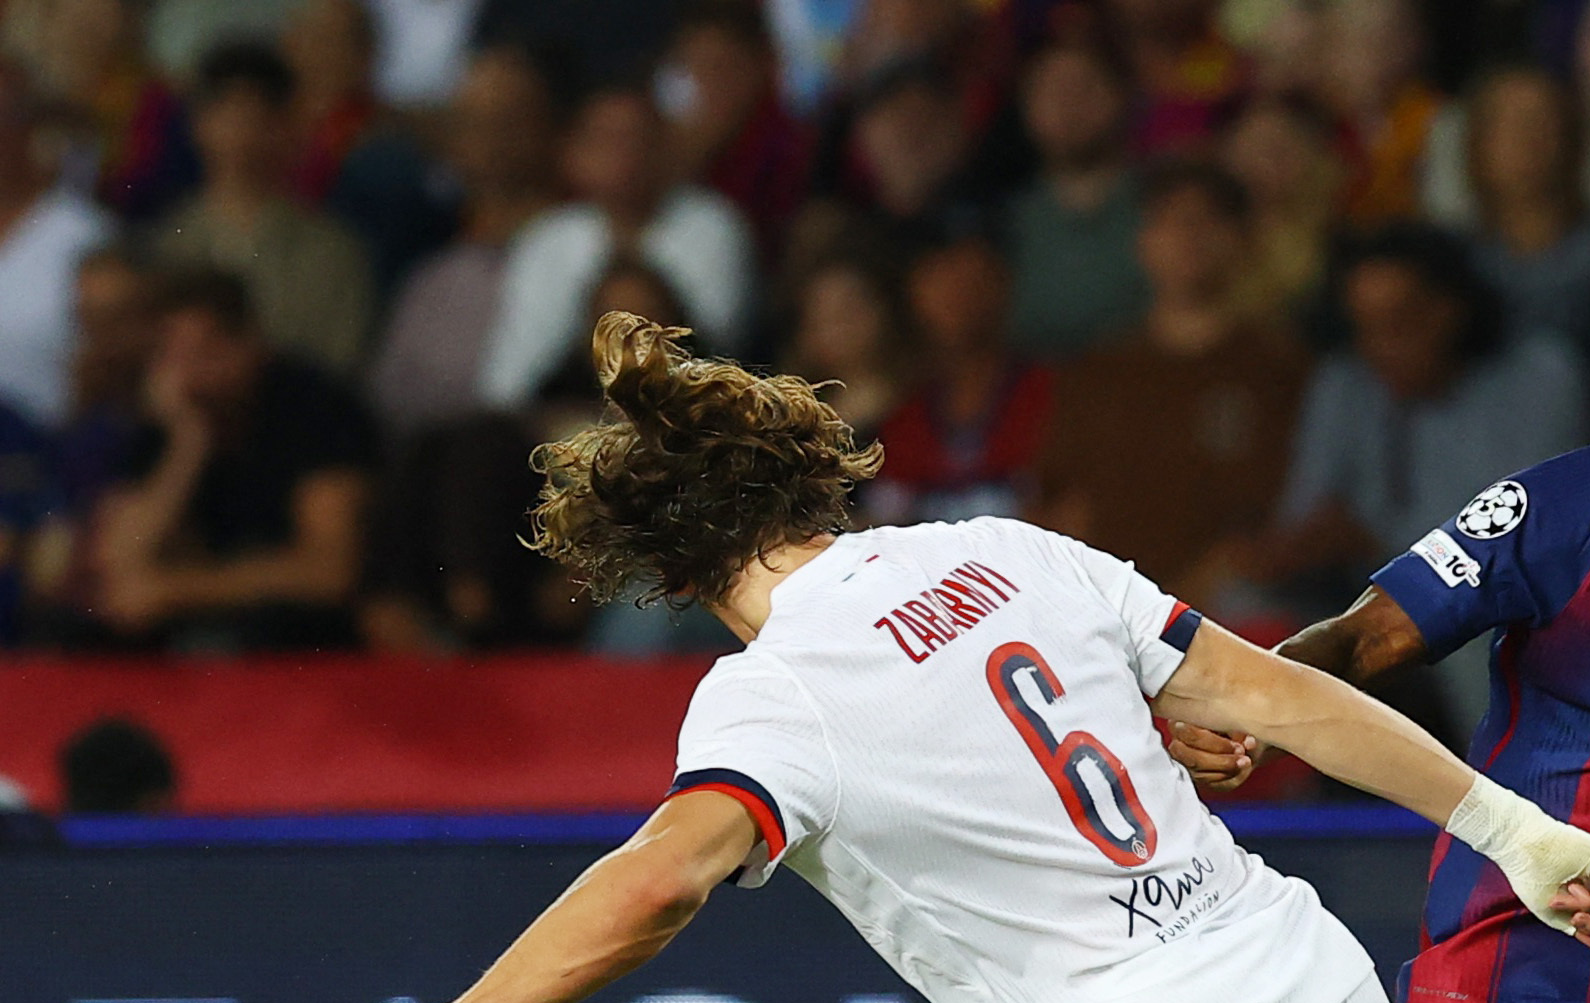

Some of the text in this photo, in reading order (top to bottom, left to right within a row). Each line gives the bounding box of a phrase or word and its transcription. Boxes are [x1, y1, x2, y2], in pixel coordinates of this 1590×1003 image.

[873, 560, 1020, 664] ZABARNYI
[1445, 555, 1468, 578] 10
[986, 641, 1158, 868] 6
